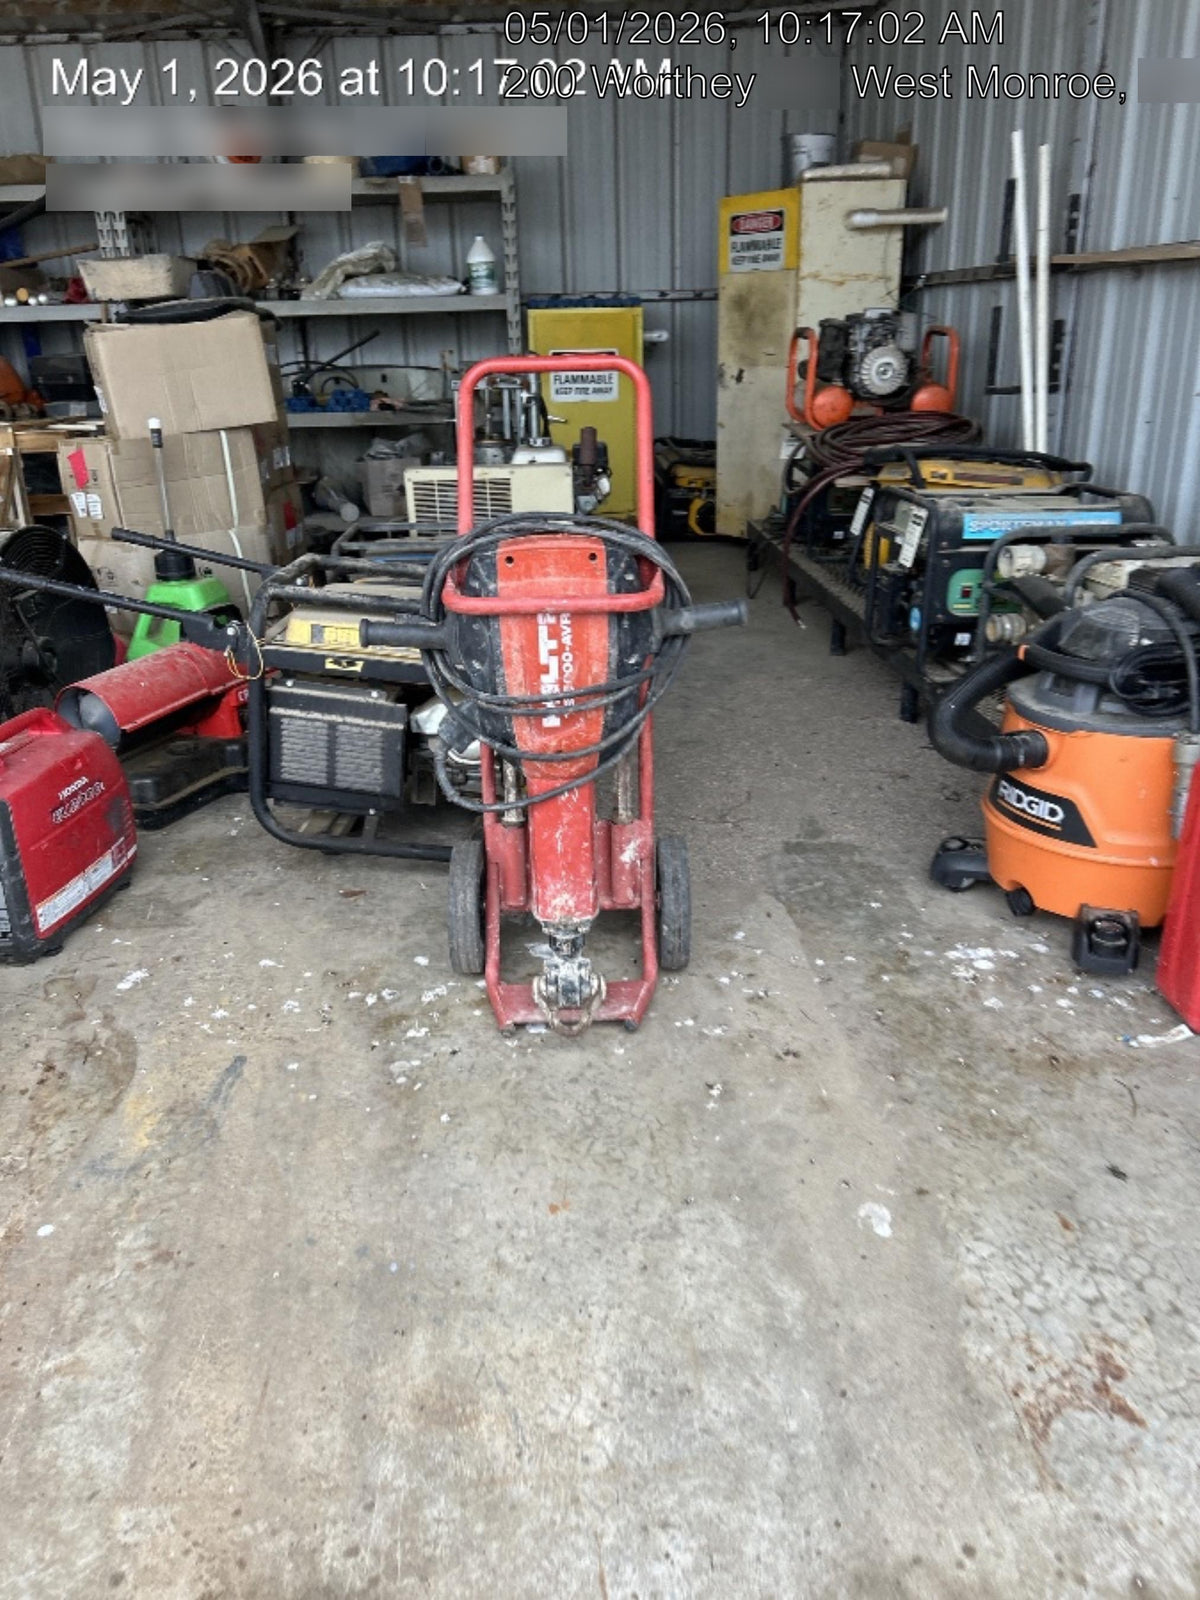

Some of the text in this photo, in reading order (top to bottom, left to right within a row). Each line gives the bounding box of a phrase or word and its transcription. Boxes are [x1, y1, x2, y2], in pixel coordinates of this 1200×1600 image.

[731, 238, 782, 253] FLAMMABLE
[553, 373, 615, 385] FLAMMABLE
[537, 609, 561, 728] HILTI
[57, 776, 89, 800] HONDA
[998, 780, 1065, 823] RIDGID
